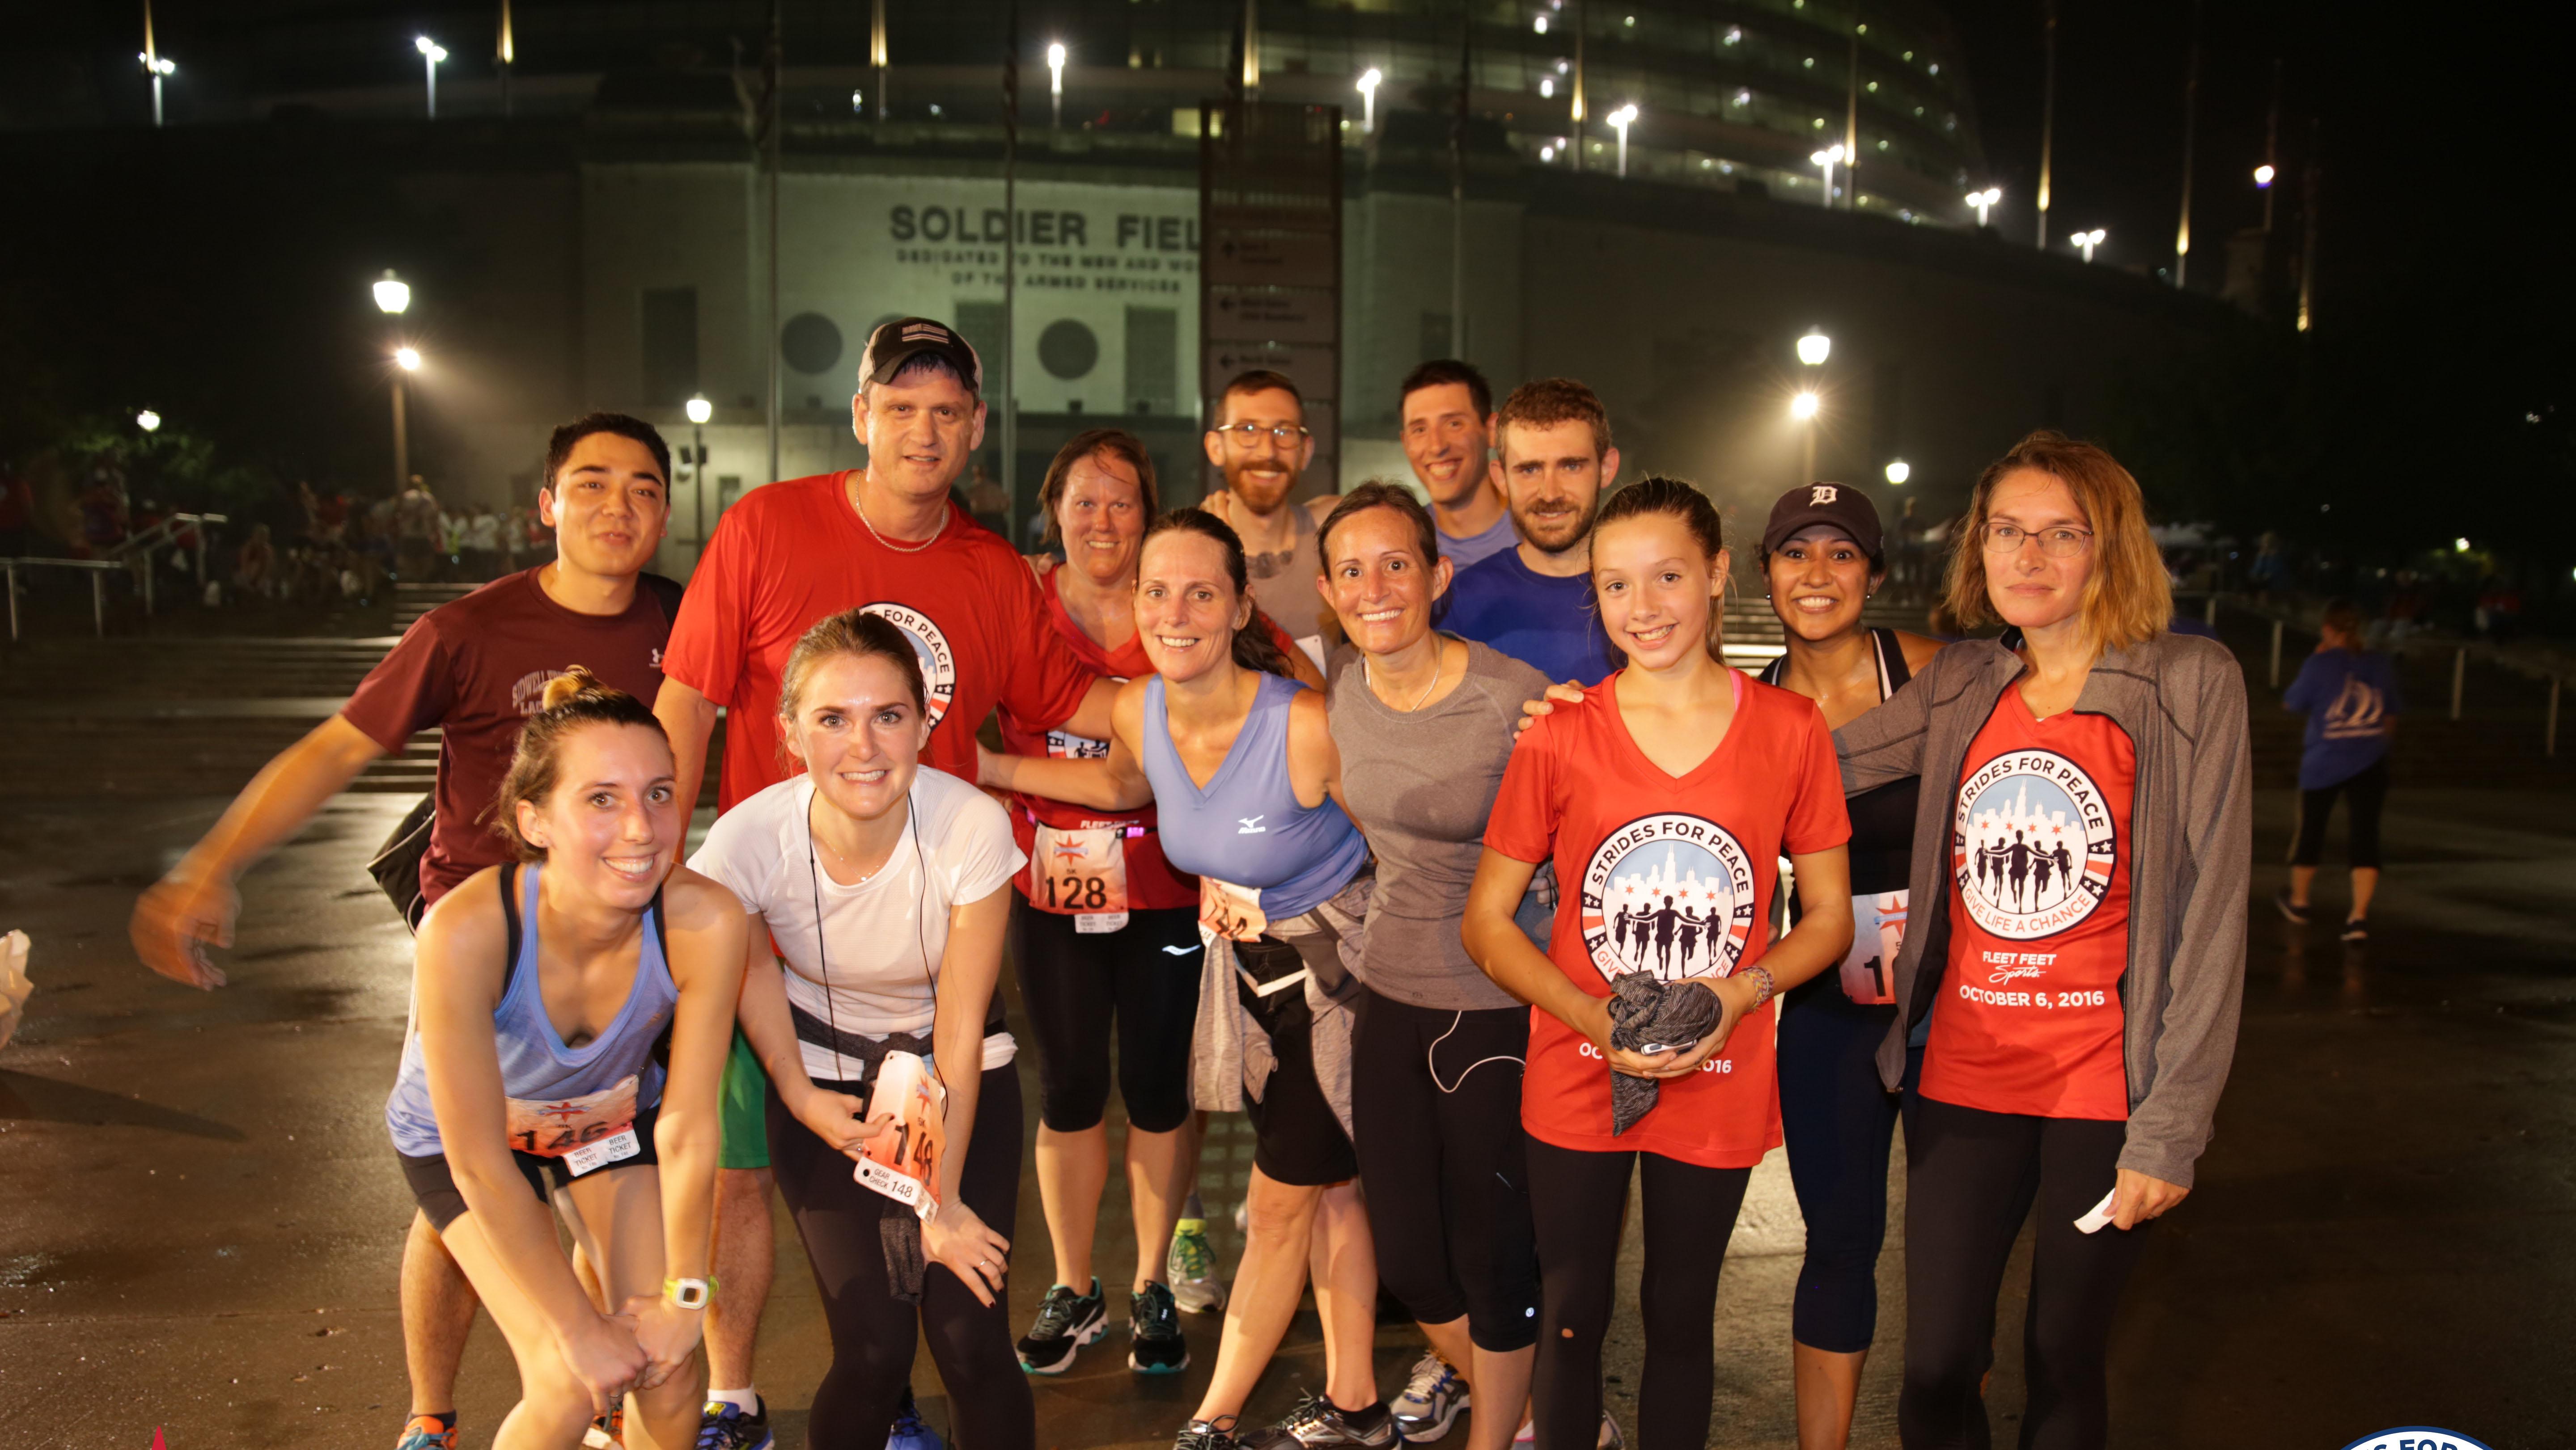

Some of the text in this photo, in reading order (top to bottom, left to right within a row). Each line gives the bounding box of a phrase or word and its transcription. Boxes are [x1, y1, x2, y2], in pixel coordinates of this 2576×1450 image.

[889, 204, 1087, 246] SOLDIER
[1810, 486, 1838, 507] D
[884, 609, 949, 673] FOR PEACE
[1958, 757, 2105, 829] STRIDES FOR PEACE
[1593, 821, 1749, 893] STRIDES FOR PEACE
[1046, 876, 1107, 909] 128
[1965, 888, 2091, 932] GIVE LIFE A CHANCE
[1983, 951, 2056, 965] FLEET FEET
[1960, 985, 2105, 1009] OCTOBER 6, 2016
[609, 1135, 626, 1145] BEER
[609, 1142, 631, 1154] TICKET
[574, 1147, 592, 1158] BEER
[575, 1153, 597, 1167] TICKET
[894, 1122, 933, 1186] 148
[869, 1176, 888, 1189] CHECK
[874, 1169, 890, 1181] GEAR
[891, 1181, 913, 1197] 148
